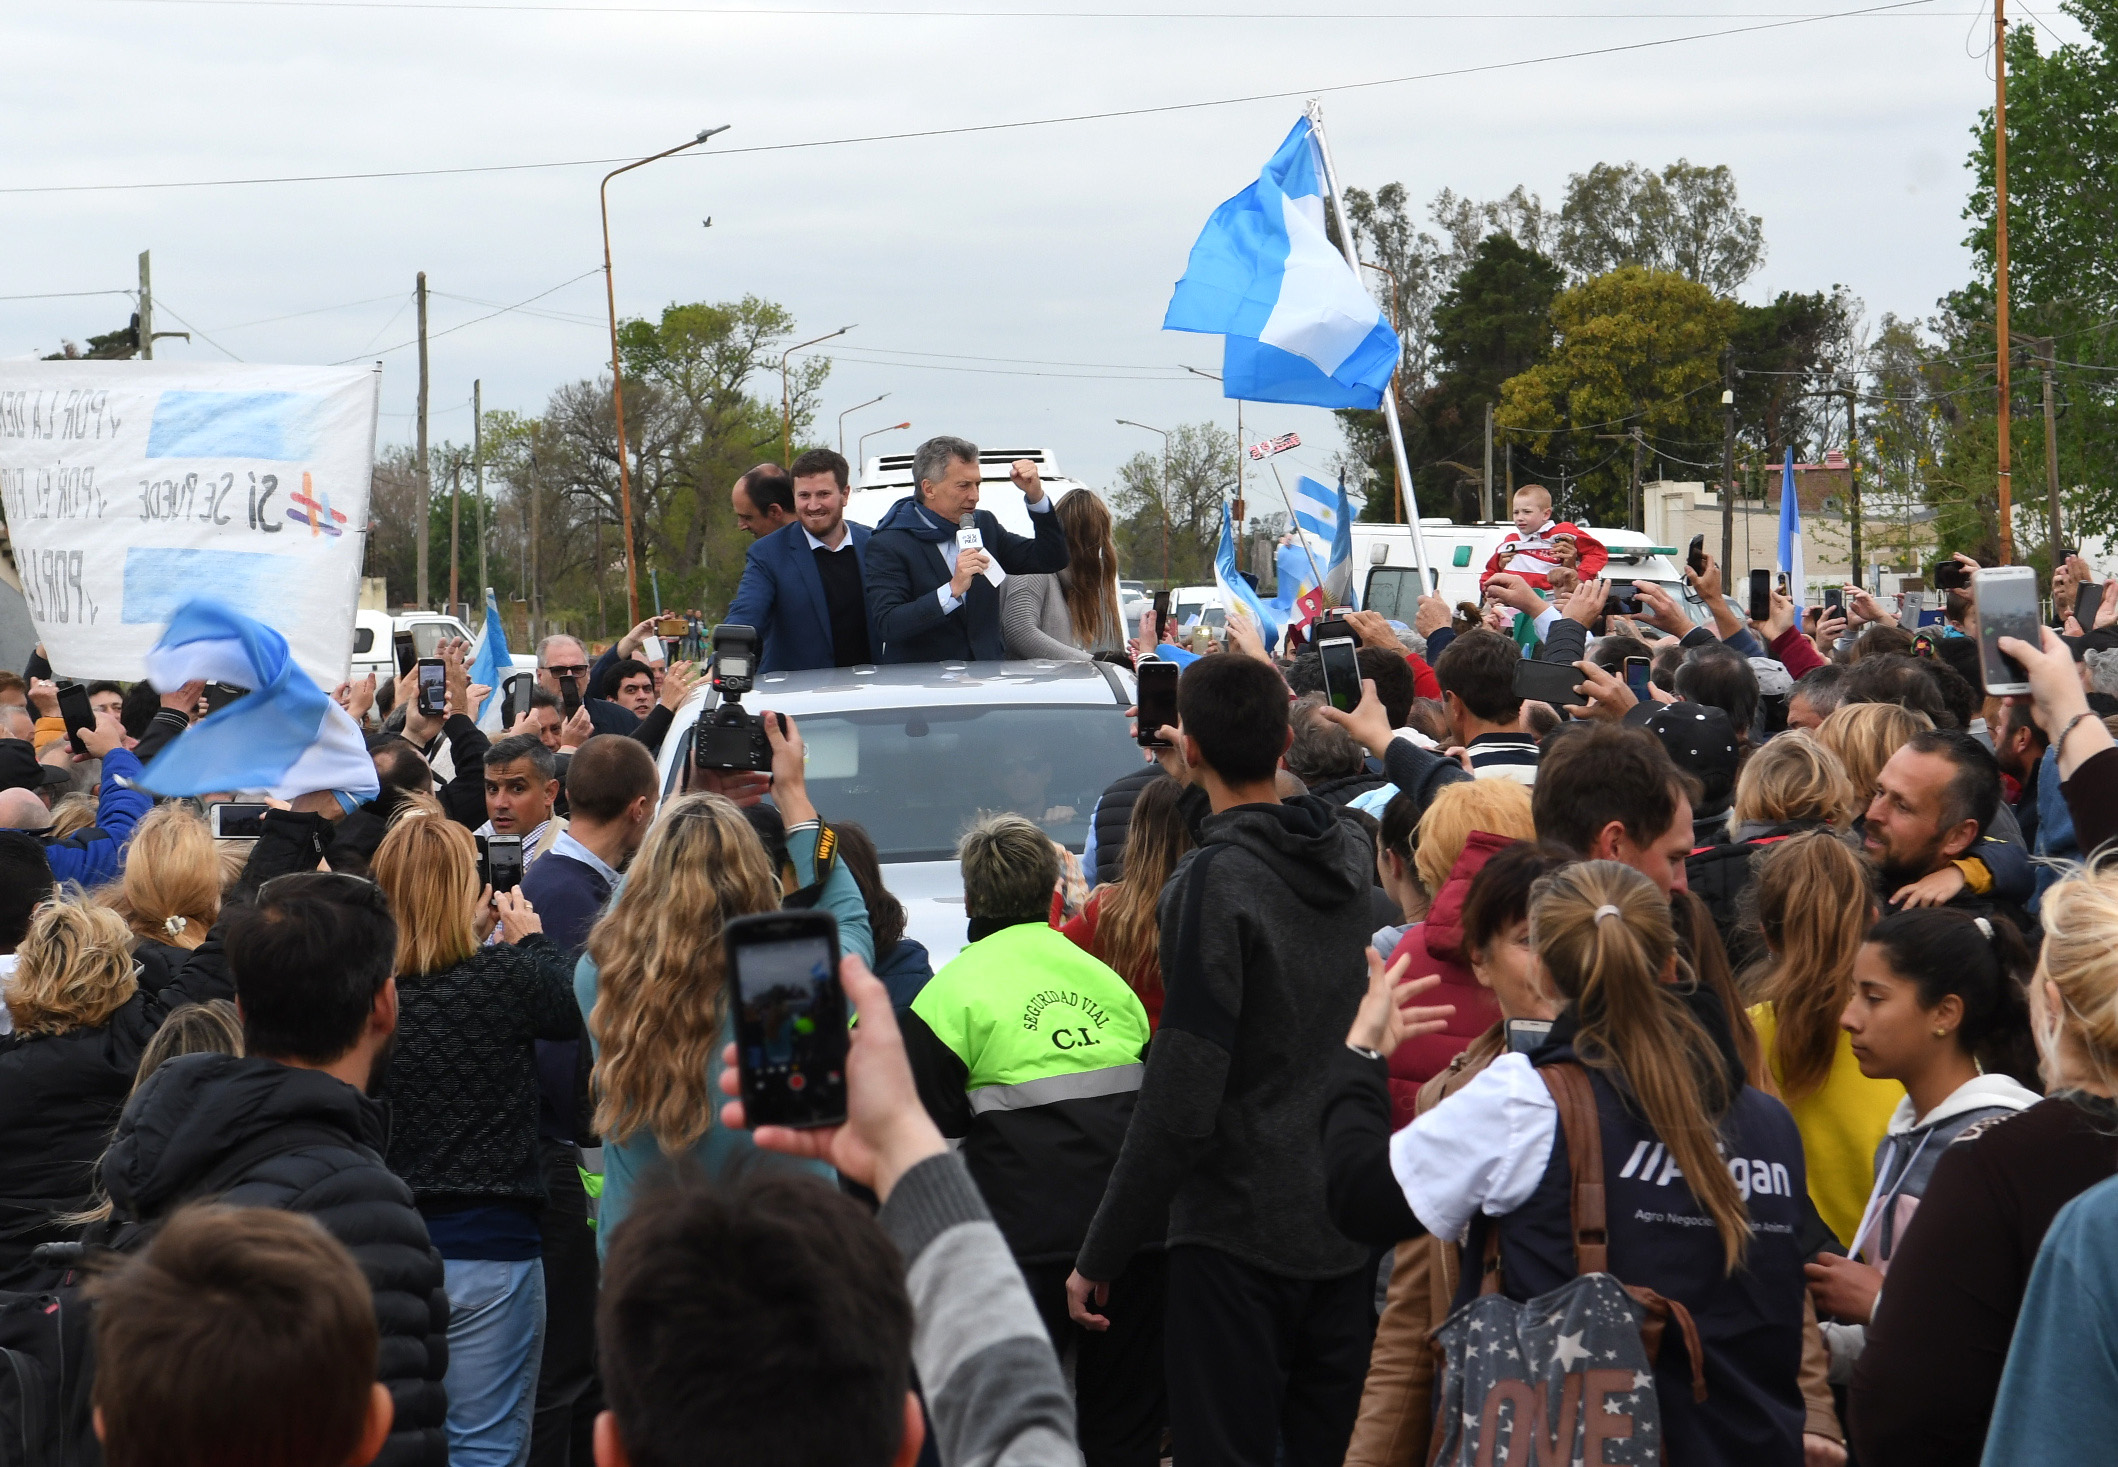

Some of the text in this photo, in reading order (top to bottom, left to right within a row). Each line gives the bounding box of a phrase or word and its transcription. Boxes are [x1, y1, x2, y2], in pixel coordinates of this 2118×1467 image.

[818, 826, 835, 860] Nikon
[1024, 990, 1110, 1032] SEGURIDAD VIAL
[1051, 1027, 1101, 1050] C.I.
[1634, 1208, 1665, 1223] Agro
